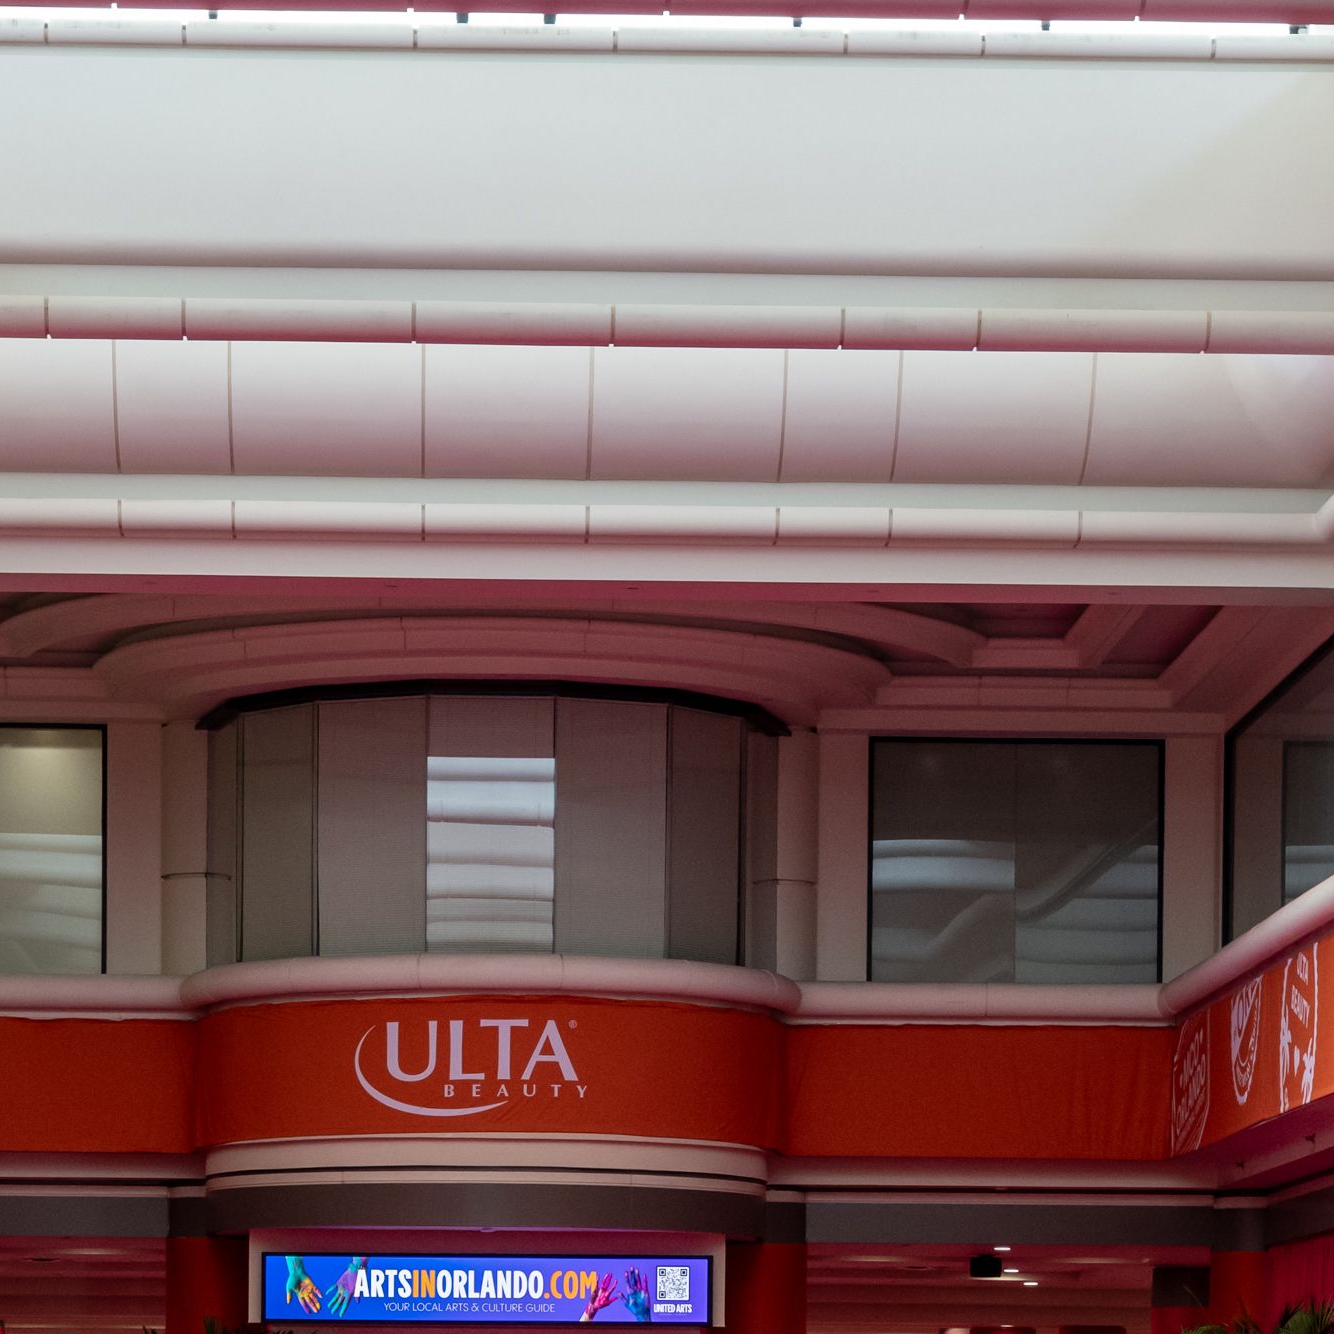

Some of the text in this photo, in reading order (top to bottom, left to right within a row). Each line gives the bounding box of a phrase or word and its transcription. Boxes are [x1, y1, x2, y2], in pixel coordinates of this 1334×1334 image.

[444, 1084, 588, 1098] BEAUTY
[354, 1270, 598, 1300] ARTSINORLANDO.COM
[383, 1302, 556, 1313] YOUR LOCAL ARTS & CULTURE GUIDE
[653, 1303, 693, 1313] UNITED ARTS
